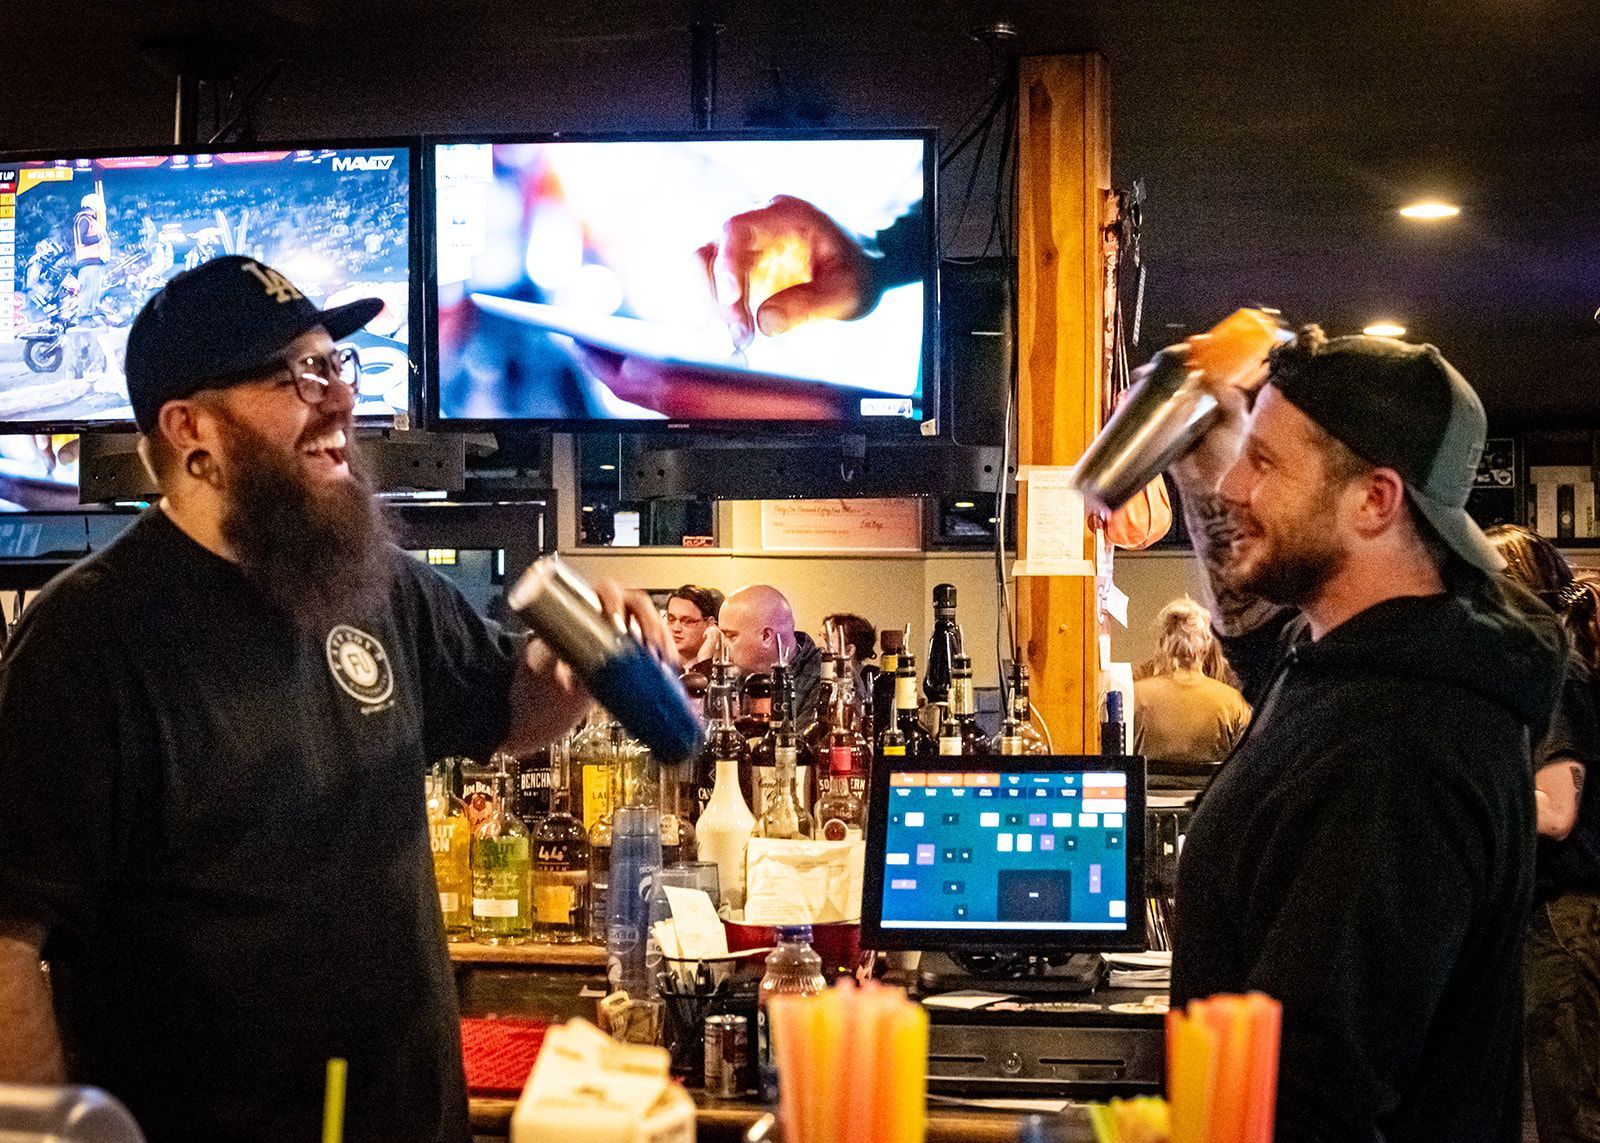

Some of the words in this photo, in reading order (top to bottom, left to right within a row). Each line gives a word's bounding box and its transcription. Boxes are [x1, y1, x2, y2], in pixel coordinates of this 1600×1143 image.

[475, 780, 493, 797] BEA
[521, 772, 551, 790] BENCHM
[819, 778, 866, 791] SOERN
[429, 824, 455, 839] LUT
[430, 837, 450, 853] ON
